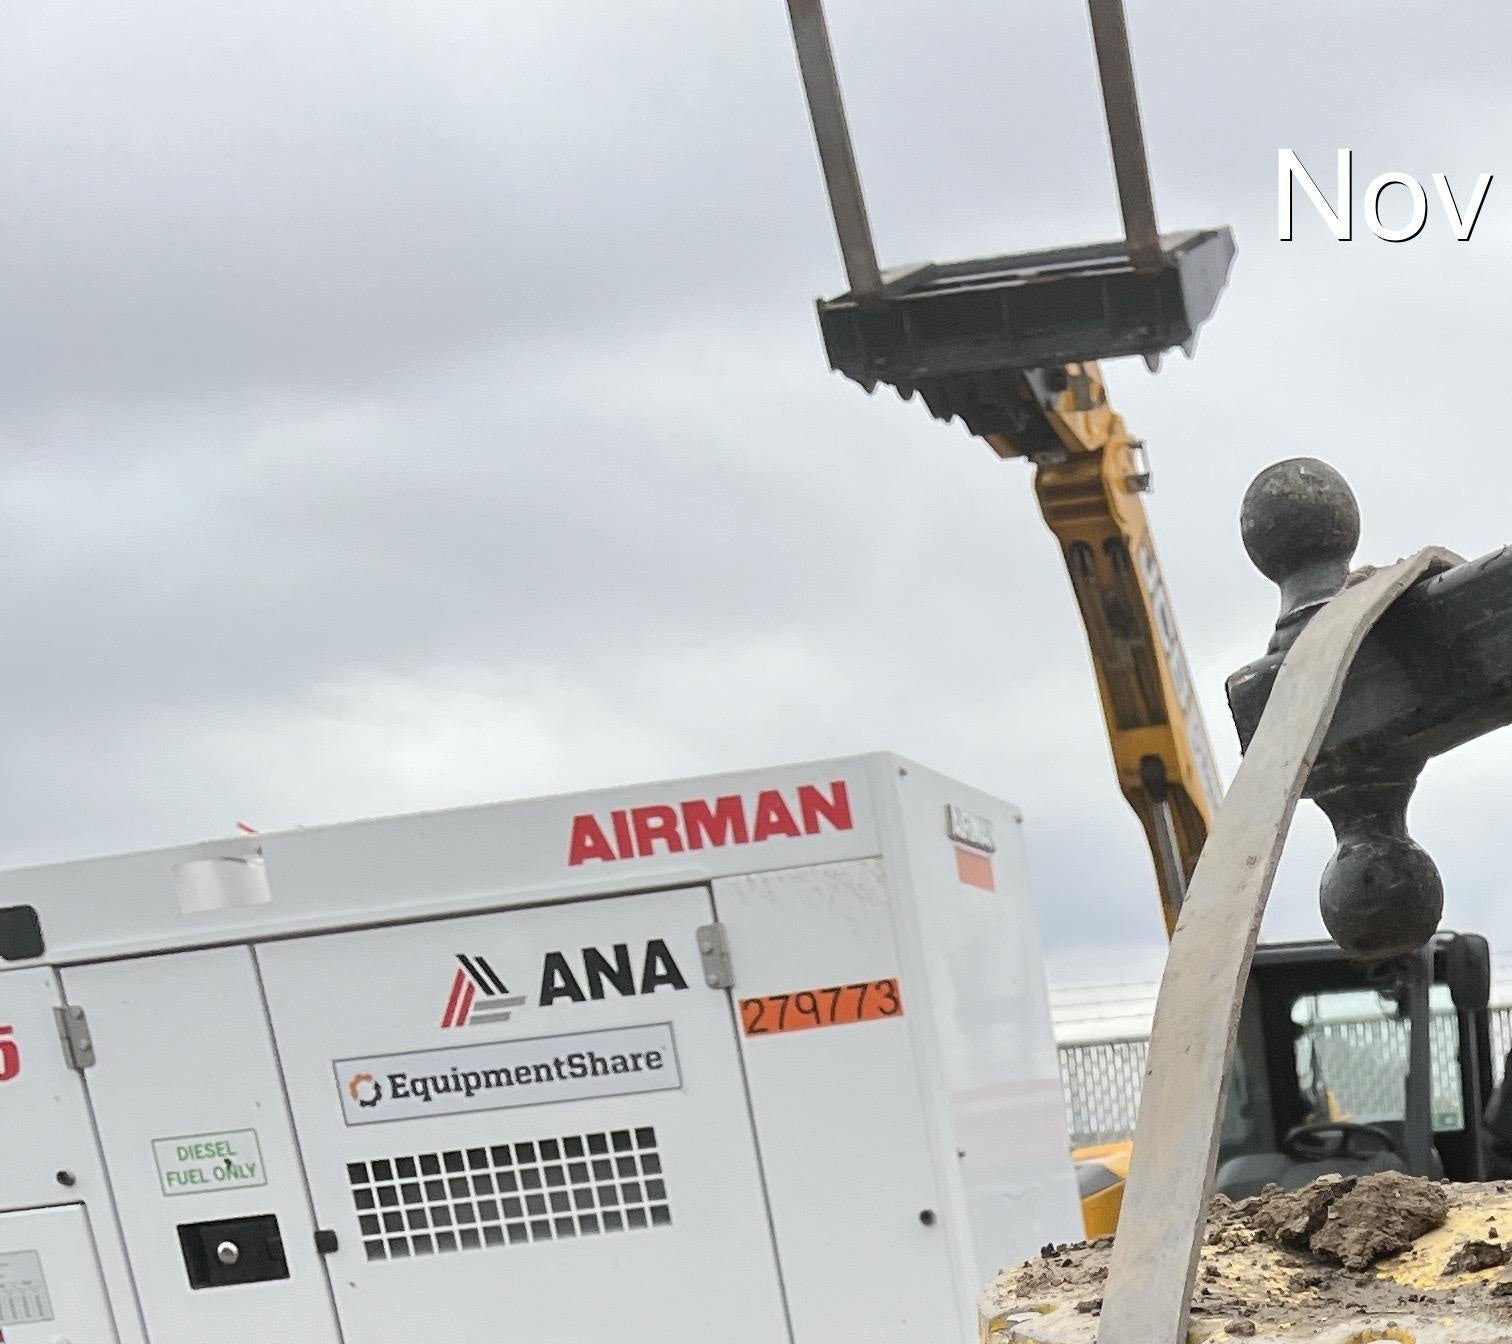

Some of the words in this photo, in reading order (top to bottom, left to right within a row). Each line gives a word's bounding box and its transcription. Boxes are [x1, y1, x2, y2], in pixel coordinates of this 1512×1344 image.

[568, 780, 853, 867] AIRMAN
[539, 938, 689, 1007] ANA
[742, 977, 900, 1034] 279773
[386, 1049, 664, 1102] EquipmentShare
[167, 1169, 209, 1187] FUEL
[214, 1163, 255, 1181] ONLY
[177, 1141, 236, 1161] DIESEL
